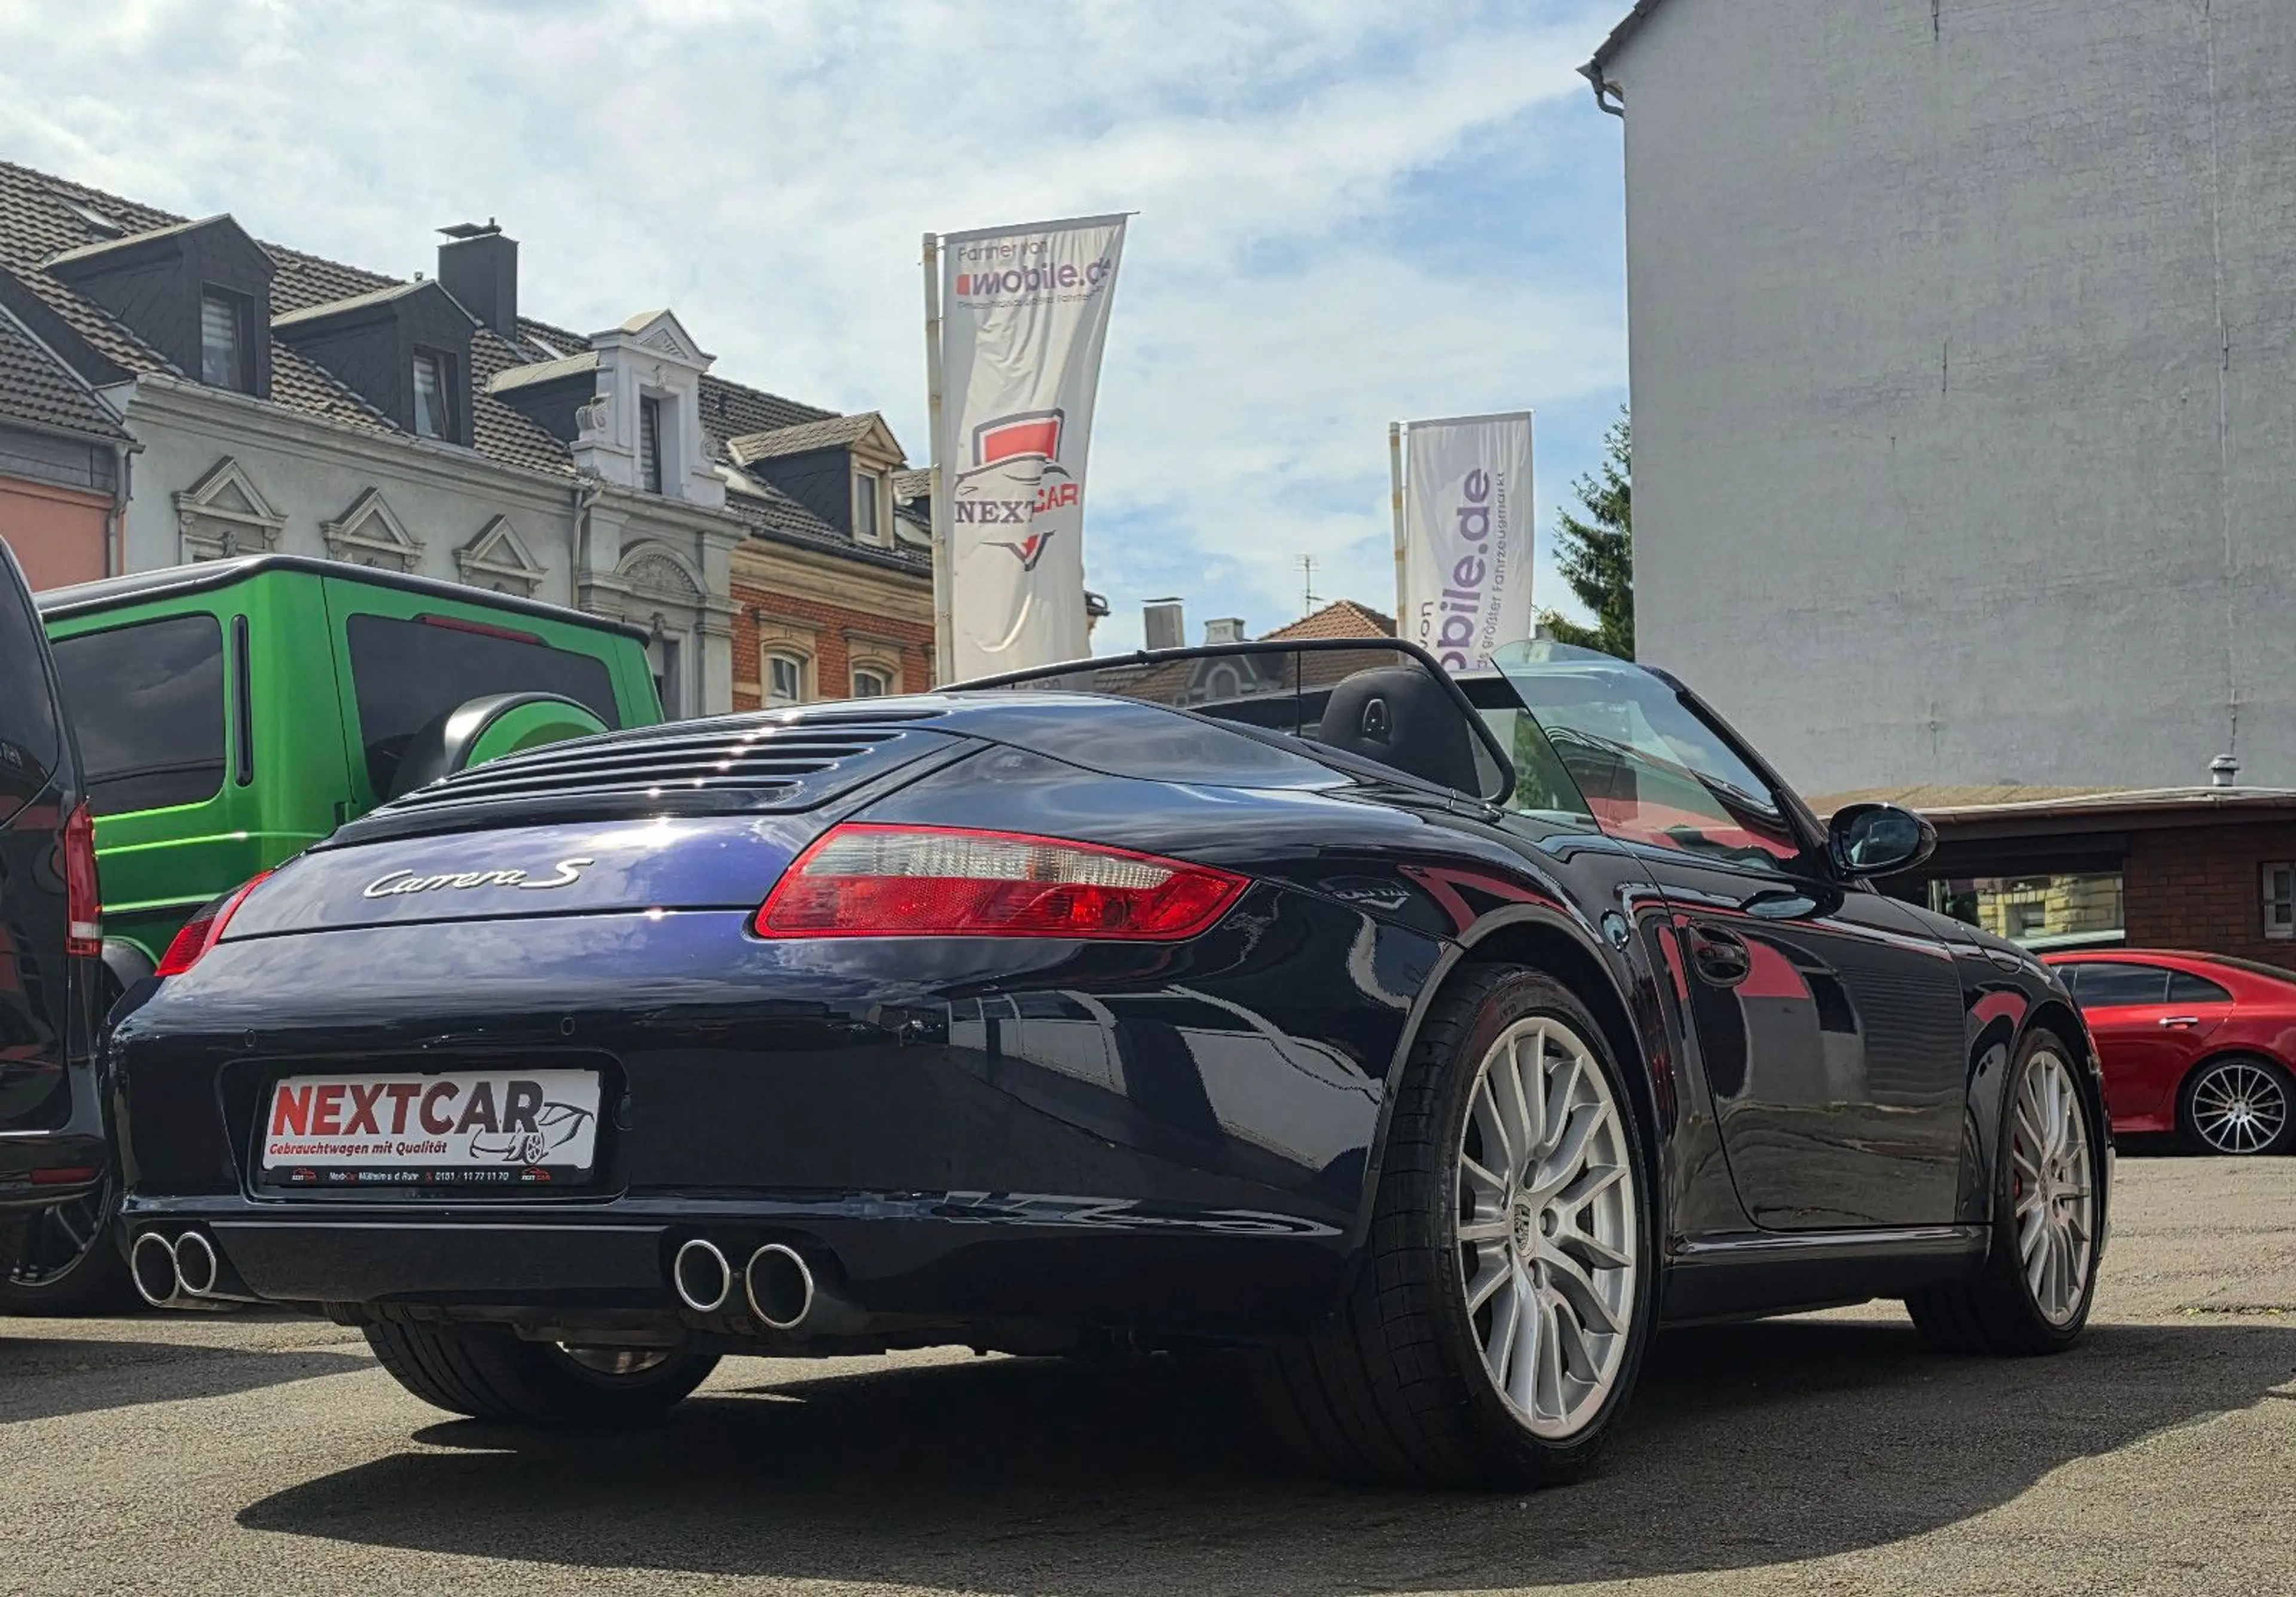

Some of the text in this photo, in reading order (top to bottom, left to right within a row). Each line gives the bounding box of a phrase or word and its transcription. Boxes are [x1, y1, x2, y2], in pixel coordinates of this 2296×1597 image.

[1492, 471, 1508, 592] Fahrzeugmarkt
[363, 857, 595, 898] Carrera S
[271, 1080, 545, 1137] NEXTCAR
[269, 1140, 447, 1157] Gebrauchtwagen mit Qualität
